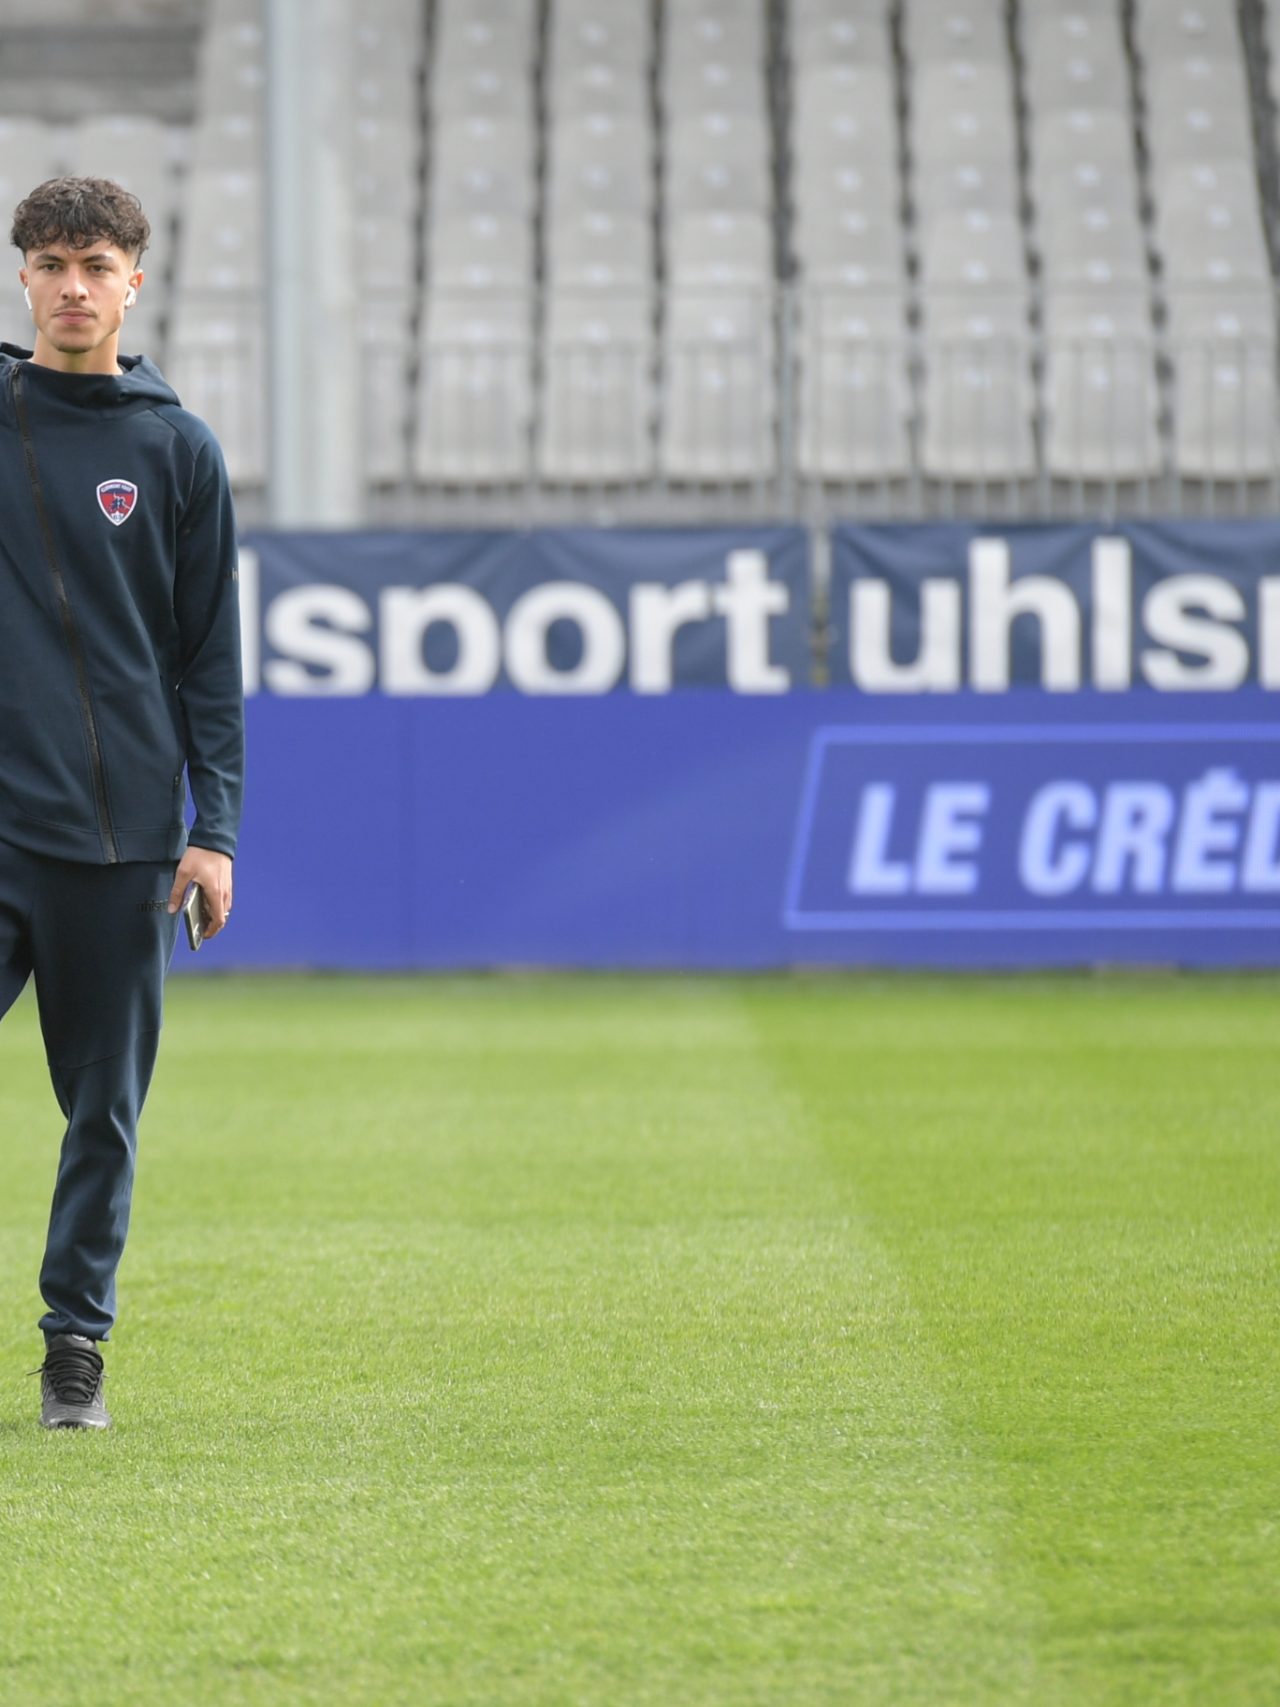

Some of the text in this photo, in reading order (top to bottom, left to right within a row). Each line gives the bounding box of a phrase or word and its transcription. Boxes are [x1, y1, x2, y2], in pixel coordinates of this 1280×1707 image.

[239, 546, 792, 695] lsport
[849, 535, 1280, 694] uhls
[848, 781, 991, 896] LE
